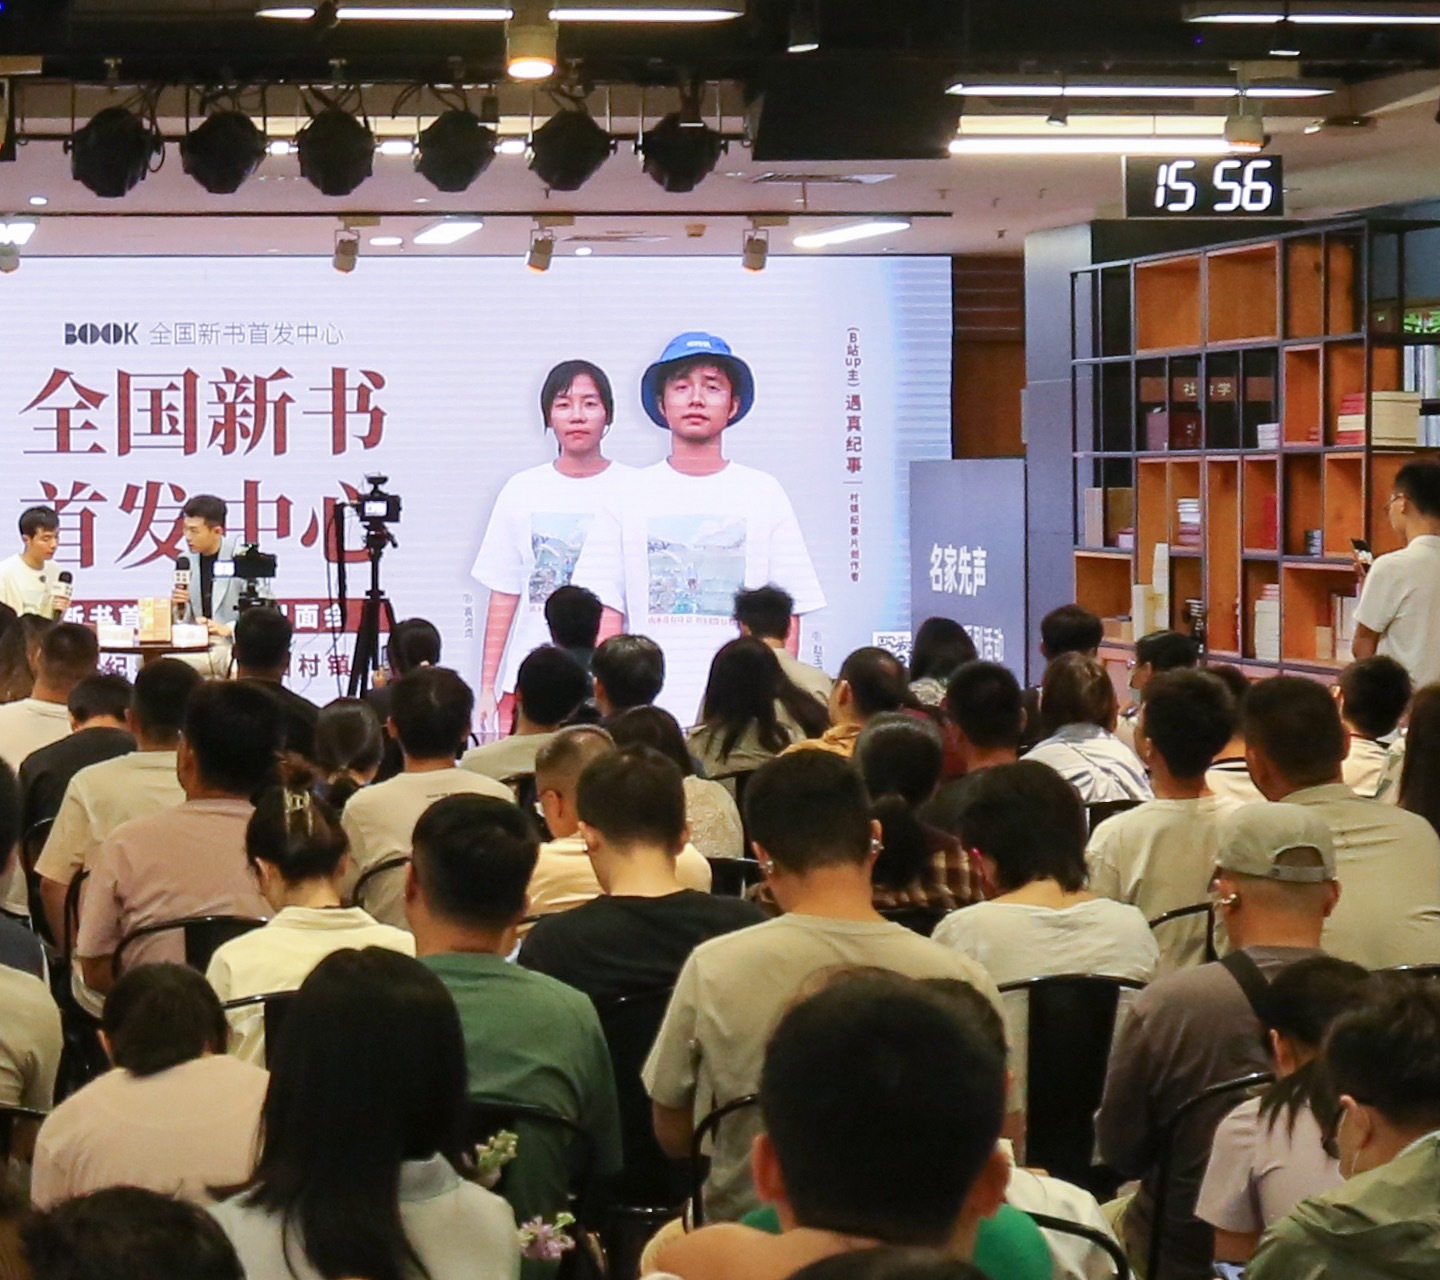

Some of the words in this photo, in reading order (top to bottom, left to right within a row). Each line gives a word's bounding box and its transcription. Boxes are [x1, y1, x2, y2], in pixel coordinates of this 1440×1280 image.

[1154, 160, 1197, 211] 15
[1212, 160, 1274, 211] 56
[64, 322, 139, 346] BOOK
[149, 321, 344, 346] 全国新书首发中心
[19, 366, 388, 457] 全国新书
[1183, 382, 1231, 397] 社学
[846, 394, 862, 474] 遇真纪事
[20, 479, 374, 570] 首发中心
[929, 543, 988, 597] 名家先声
[281, 604, 342, 629] 面会
